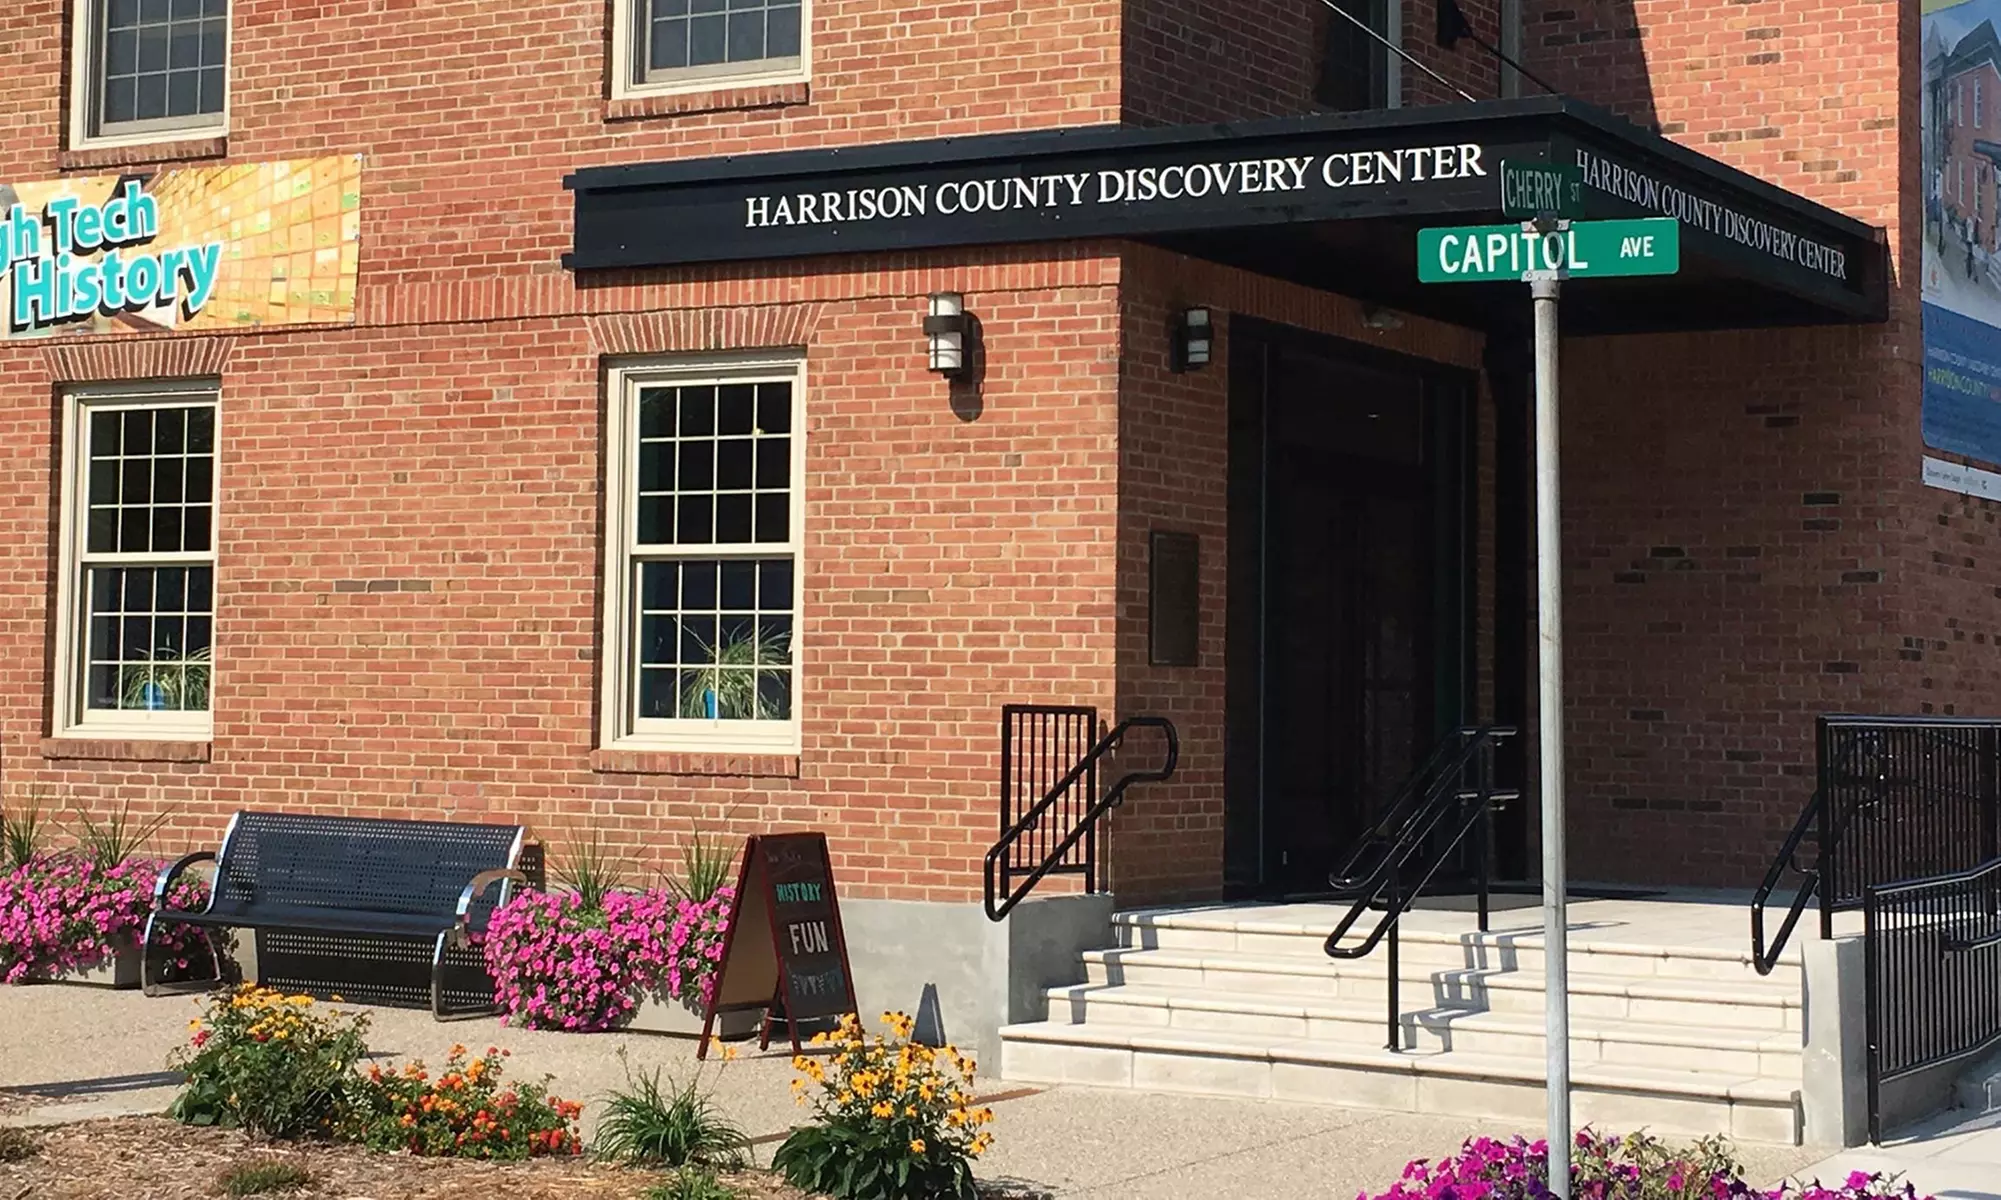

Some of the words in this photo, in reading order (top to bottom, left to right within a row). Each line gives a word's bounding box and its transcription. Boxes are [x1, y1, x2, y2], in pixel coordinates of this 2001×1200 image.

[745, 184, 928, 228] HARRISON
[935, 172, 1092, 216] COUNTY
[1097, 156, 1315, 205] DISCOVERY
[1322, 143, 1488, 188] CENTER
[1505, 168, 1562, 212] CHERRY
[1569, 182, 1580, 203] ST
[1576, 149, 1660, 211] HARRISON
[1661, 184, 1722, 235] COUNTY
[1724, 208, 1797, 261] DISCOVERY
[1798, 237, 1846, 280] CENTER
[47, 180, 157, 253] Tech
[1438, 230, 1589, 275] CAPITOL
[1619, 235, 1655, 259] AVE
[14, 240, 225, 325] History
[775, 882, 822, 903] HISTORY
[788, 920, 830, 956] FUN
